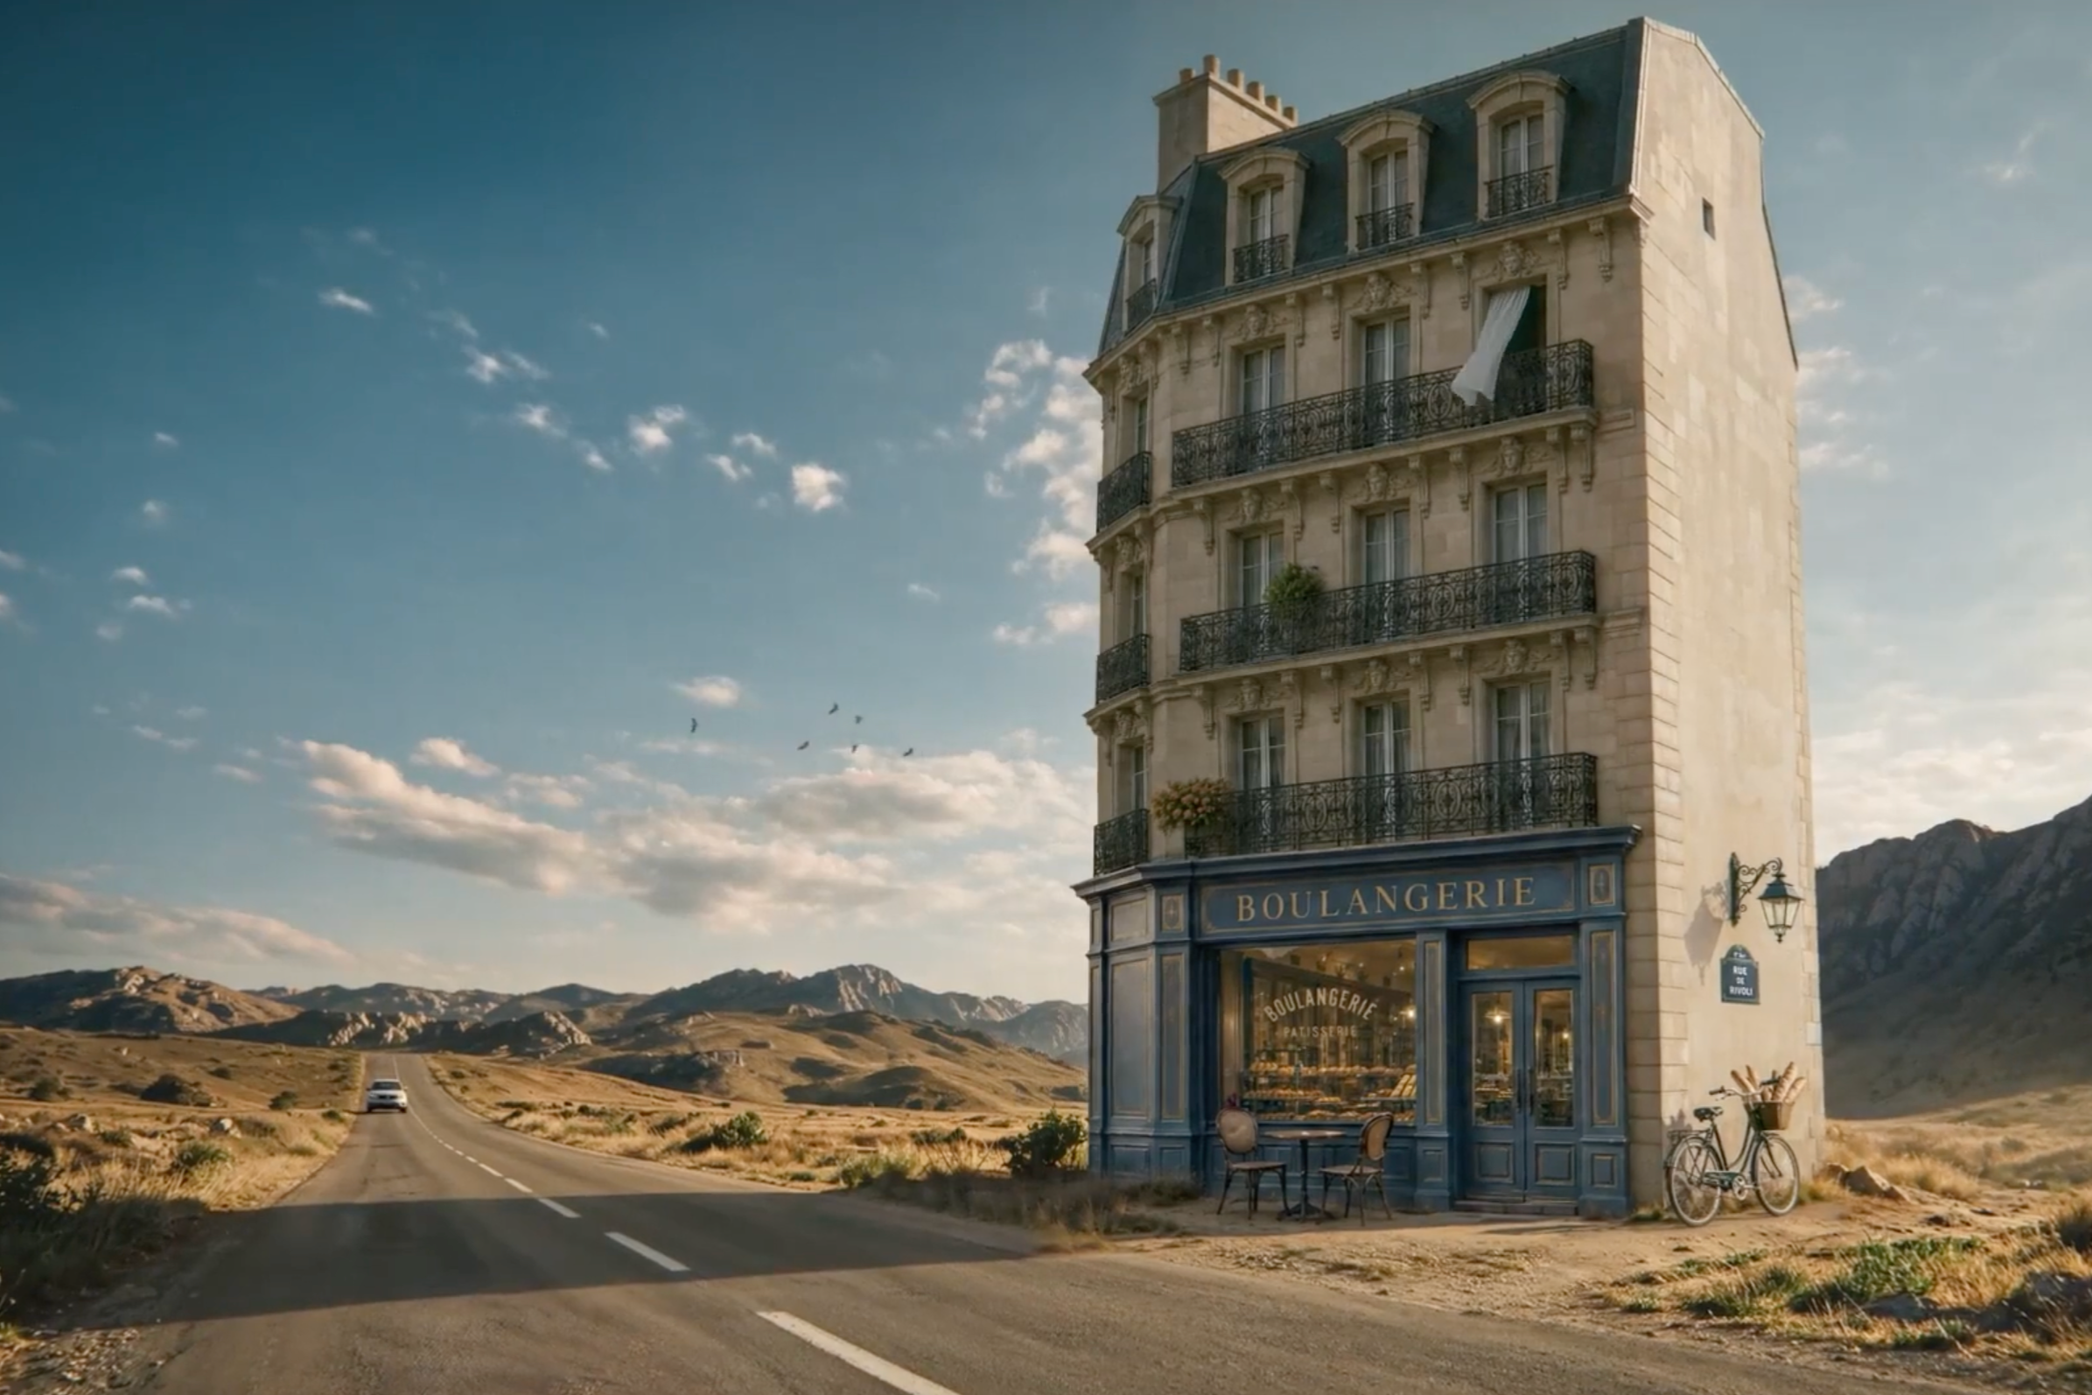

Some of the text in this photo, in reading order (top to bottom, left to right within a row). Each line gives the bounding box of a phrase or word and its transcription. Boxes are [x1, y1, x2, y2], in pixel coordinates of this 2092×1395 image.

[1236, 877, 1537, 922] BOULANGERIE
[1733, 965, 1747, 976] RUE
[1736, 977, 1745, 985] DE
[1729, 986, 1753, 996] RIVOLI
[1263, 987, 1378, 1022] BOULANGERIE
[1283, 1025, 1357, 1038] PATISSERIE
